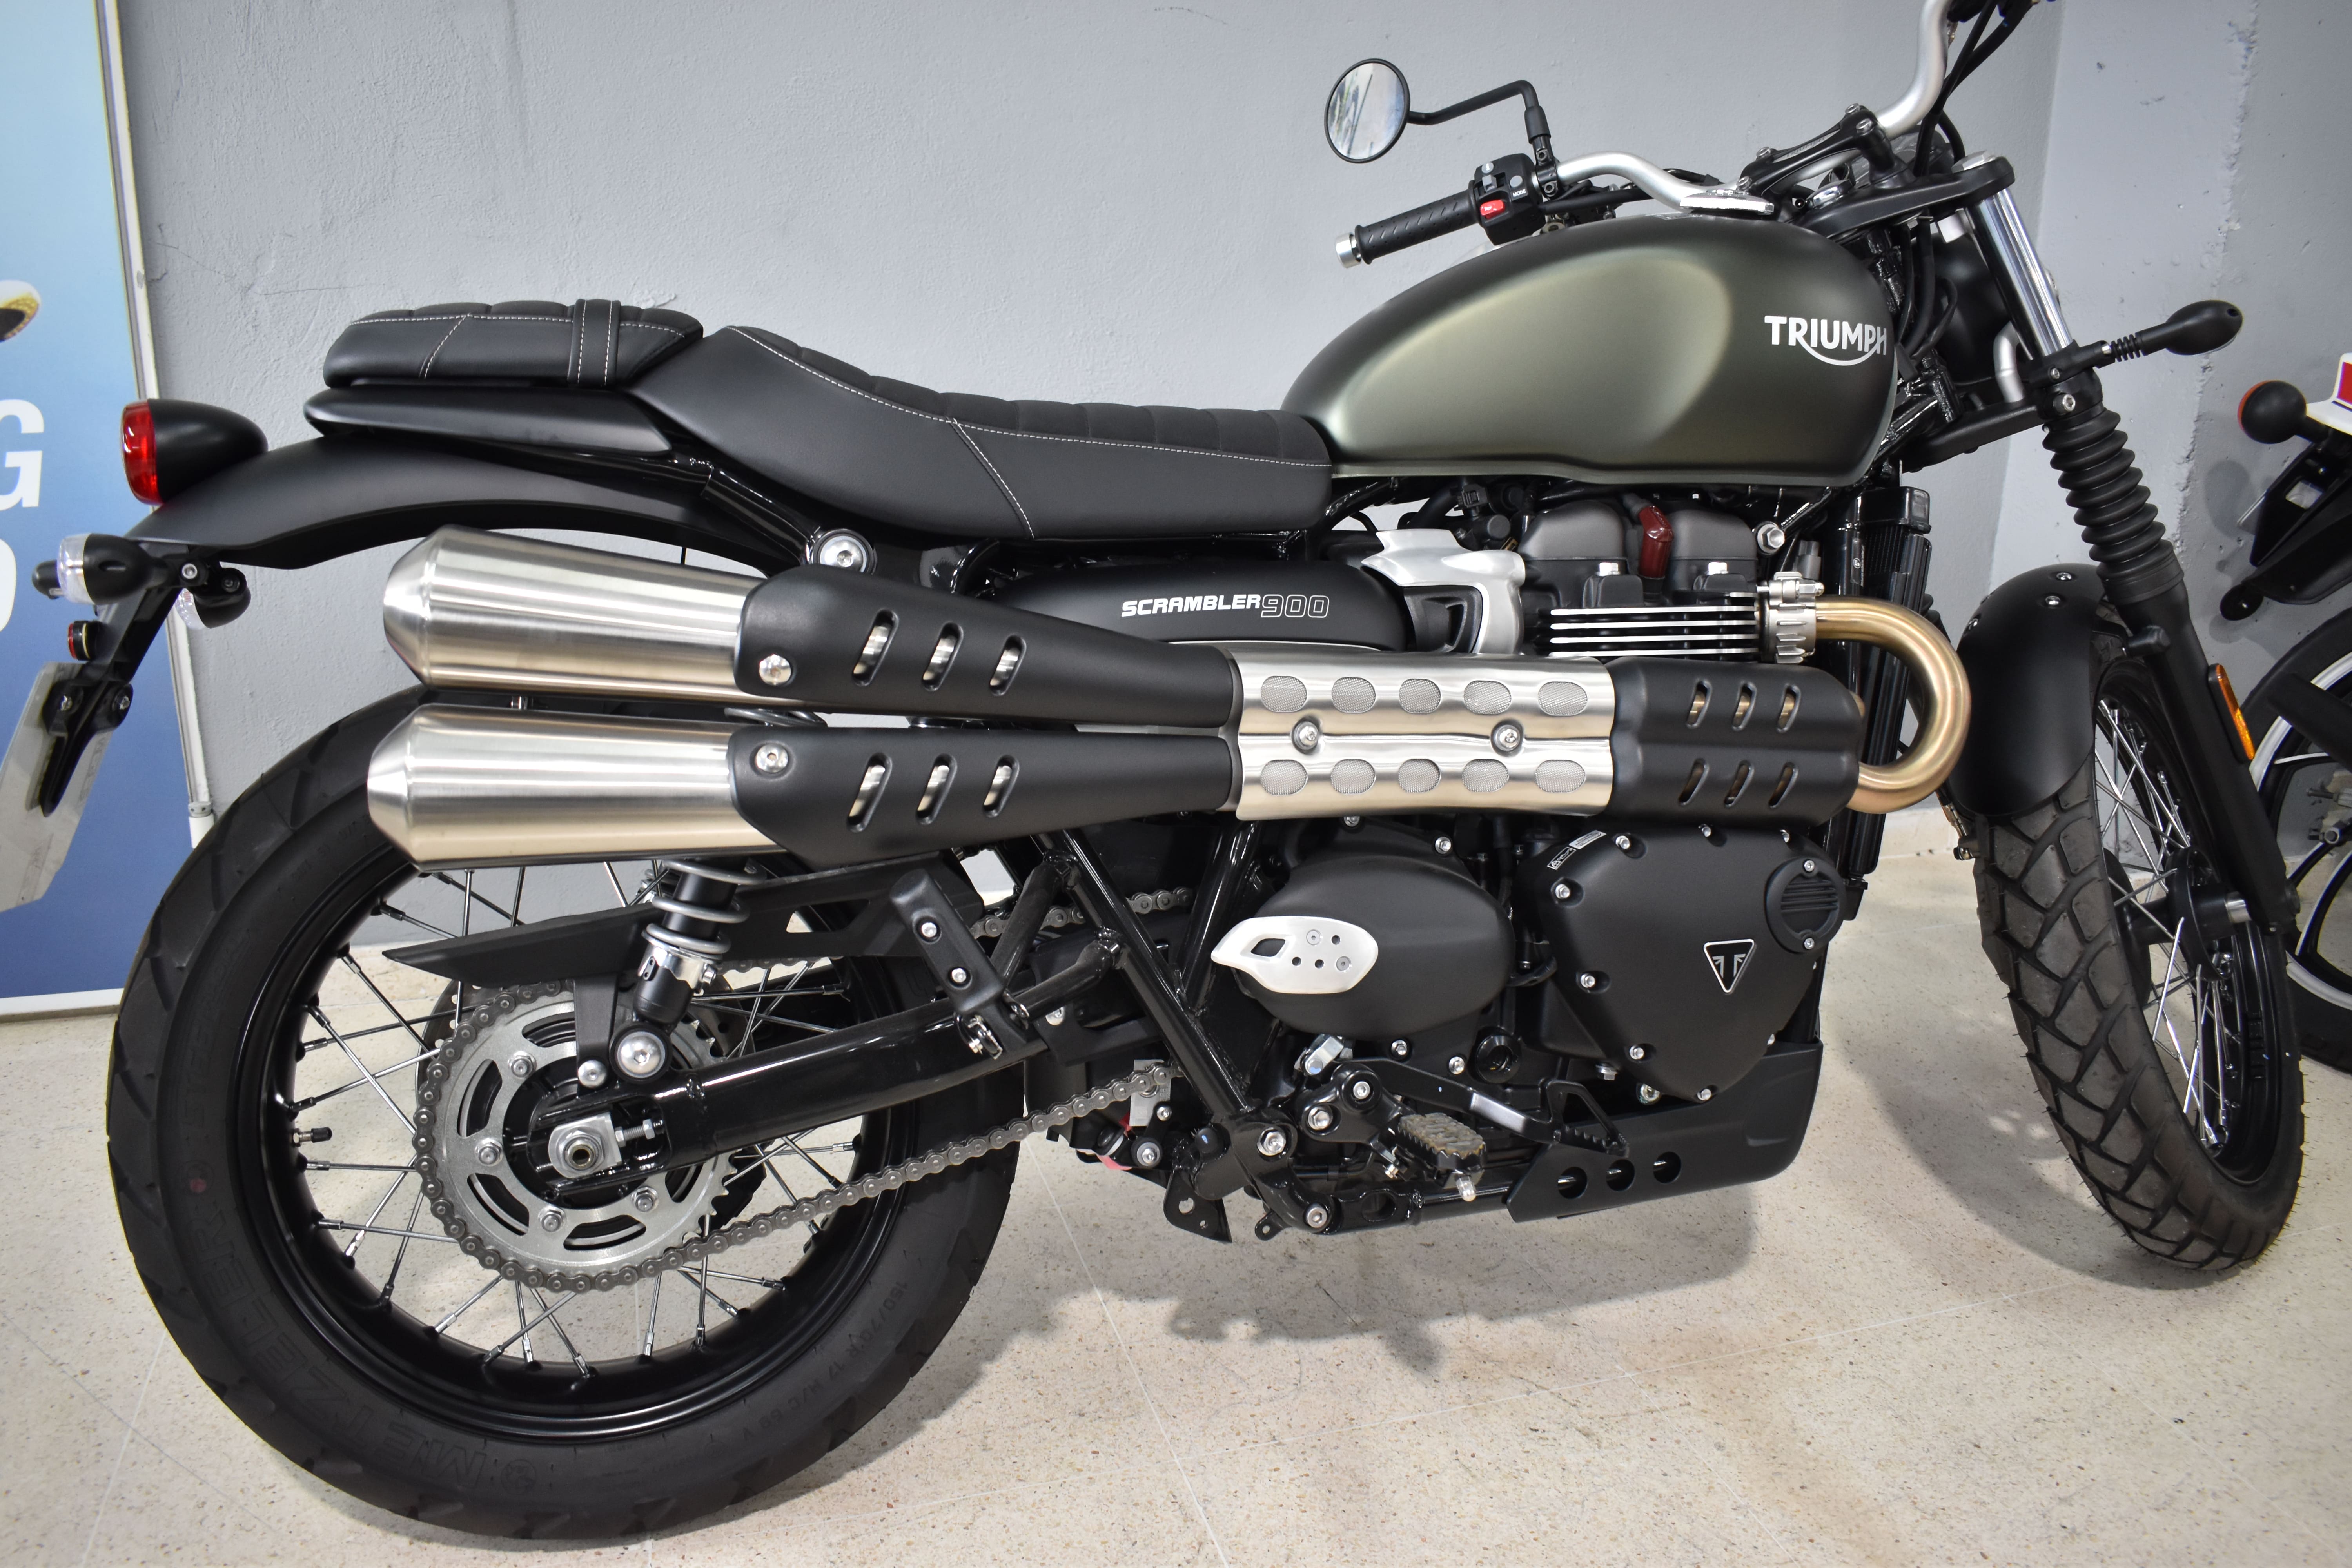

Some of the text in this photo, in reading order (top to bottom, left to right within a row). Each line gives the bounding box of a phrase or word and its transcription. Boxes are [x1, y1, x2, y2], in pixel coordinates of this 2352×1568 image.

[1513, 189, 1526, 197] MODE
[1764, 316, 1887, 366] TRIUMPH
[185, 1209, 487, 1490] METZELER
